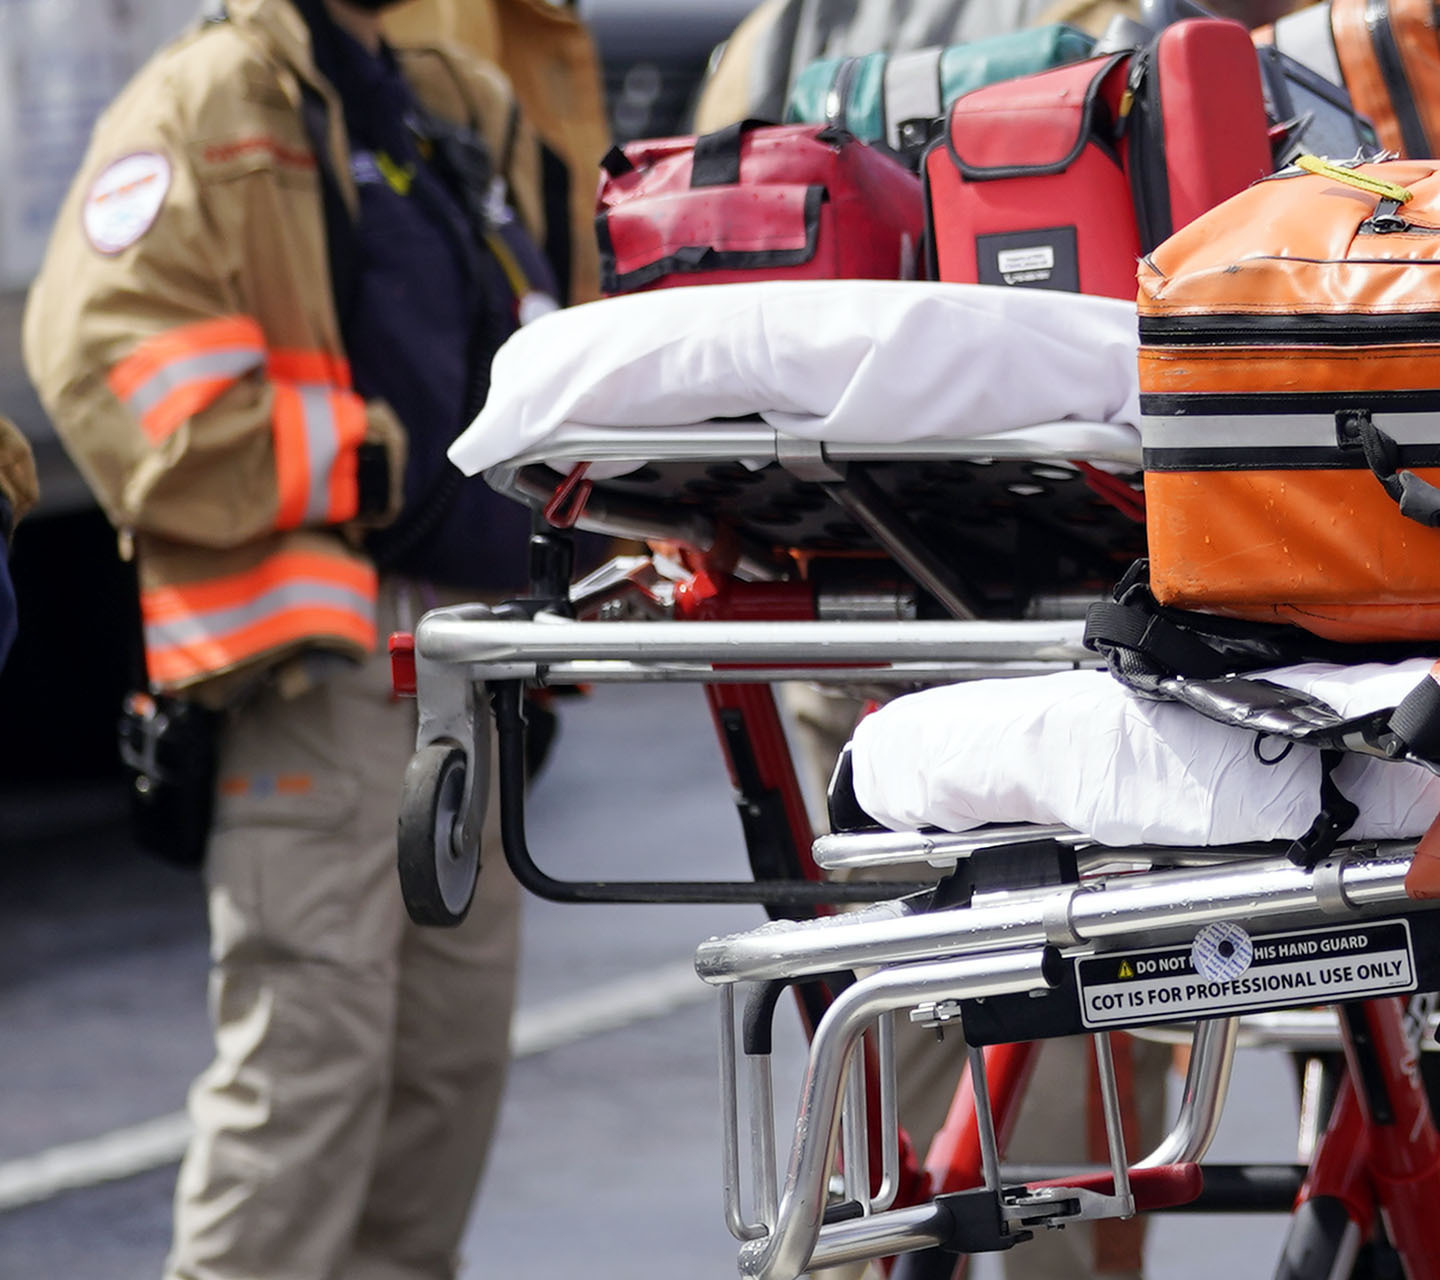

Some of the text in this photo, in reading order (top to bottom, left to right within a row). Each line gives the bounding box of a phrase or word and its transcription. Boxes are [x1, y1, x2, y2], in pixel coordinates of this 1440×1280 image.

[1136, 935, 1368, 974] DO NOT HIS HAND GUARD
[1091, 960, 1403, 1011] COT IS FOR PROFESSIONAL USE ONLY
